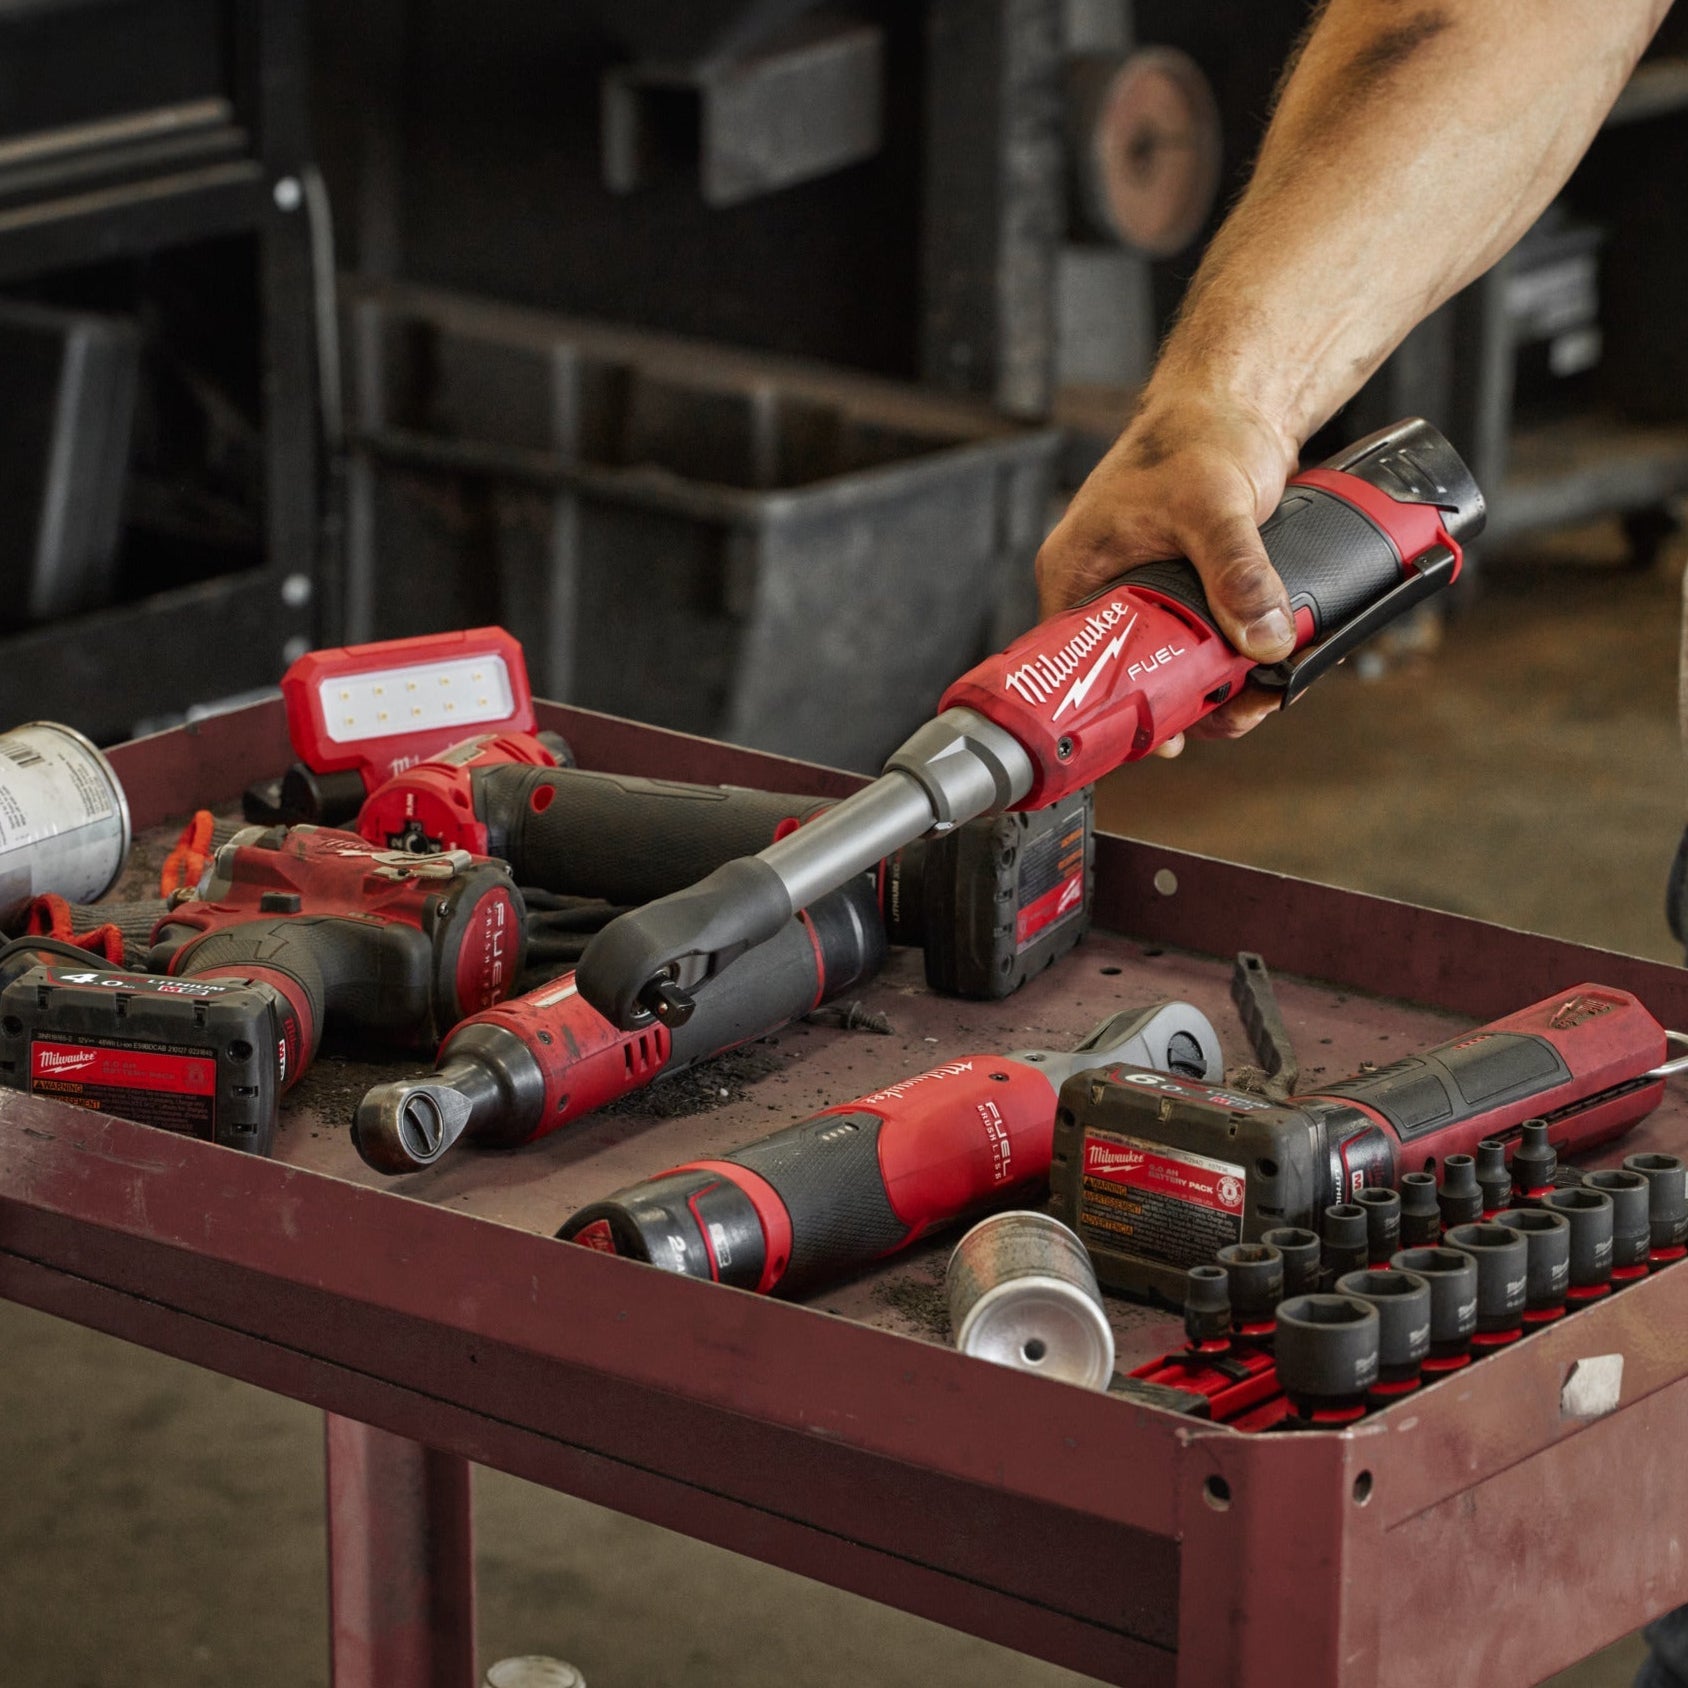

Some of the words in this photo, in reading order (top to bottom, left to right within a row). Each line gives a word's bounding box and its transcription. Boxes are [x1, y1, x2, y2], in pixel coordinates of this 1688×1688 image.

[1005, 602, 1128, 705] Milwaukee
[1127, 645, 1185, 682] FUEL
[38, 1051, 95, 1067] Milwaukee
[977, 1104, 1002, 1180] BRUSHLESS
[985, 1101, 1012, 1177] FUEL
[1088, 1145, 1144, 1164] Milwaukee
[1189, 1181, 1214, 1195] PACK
